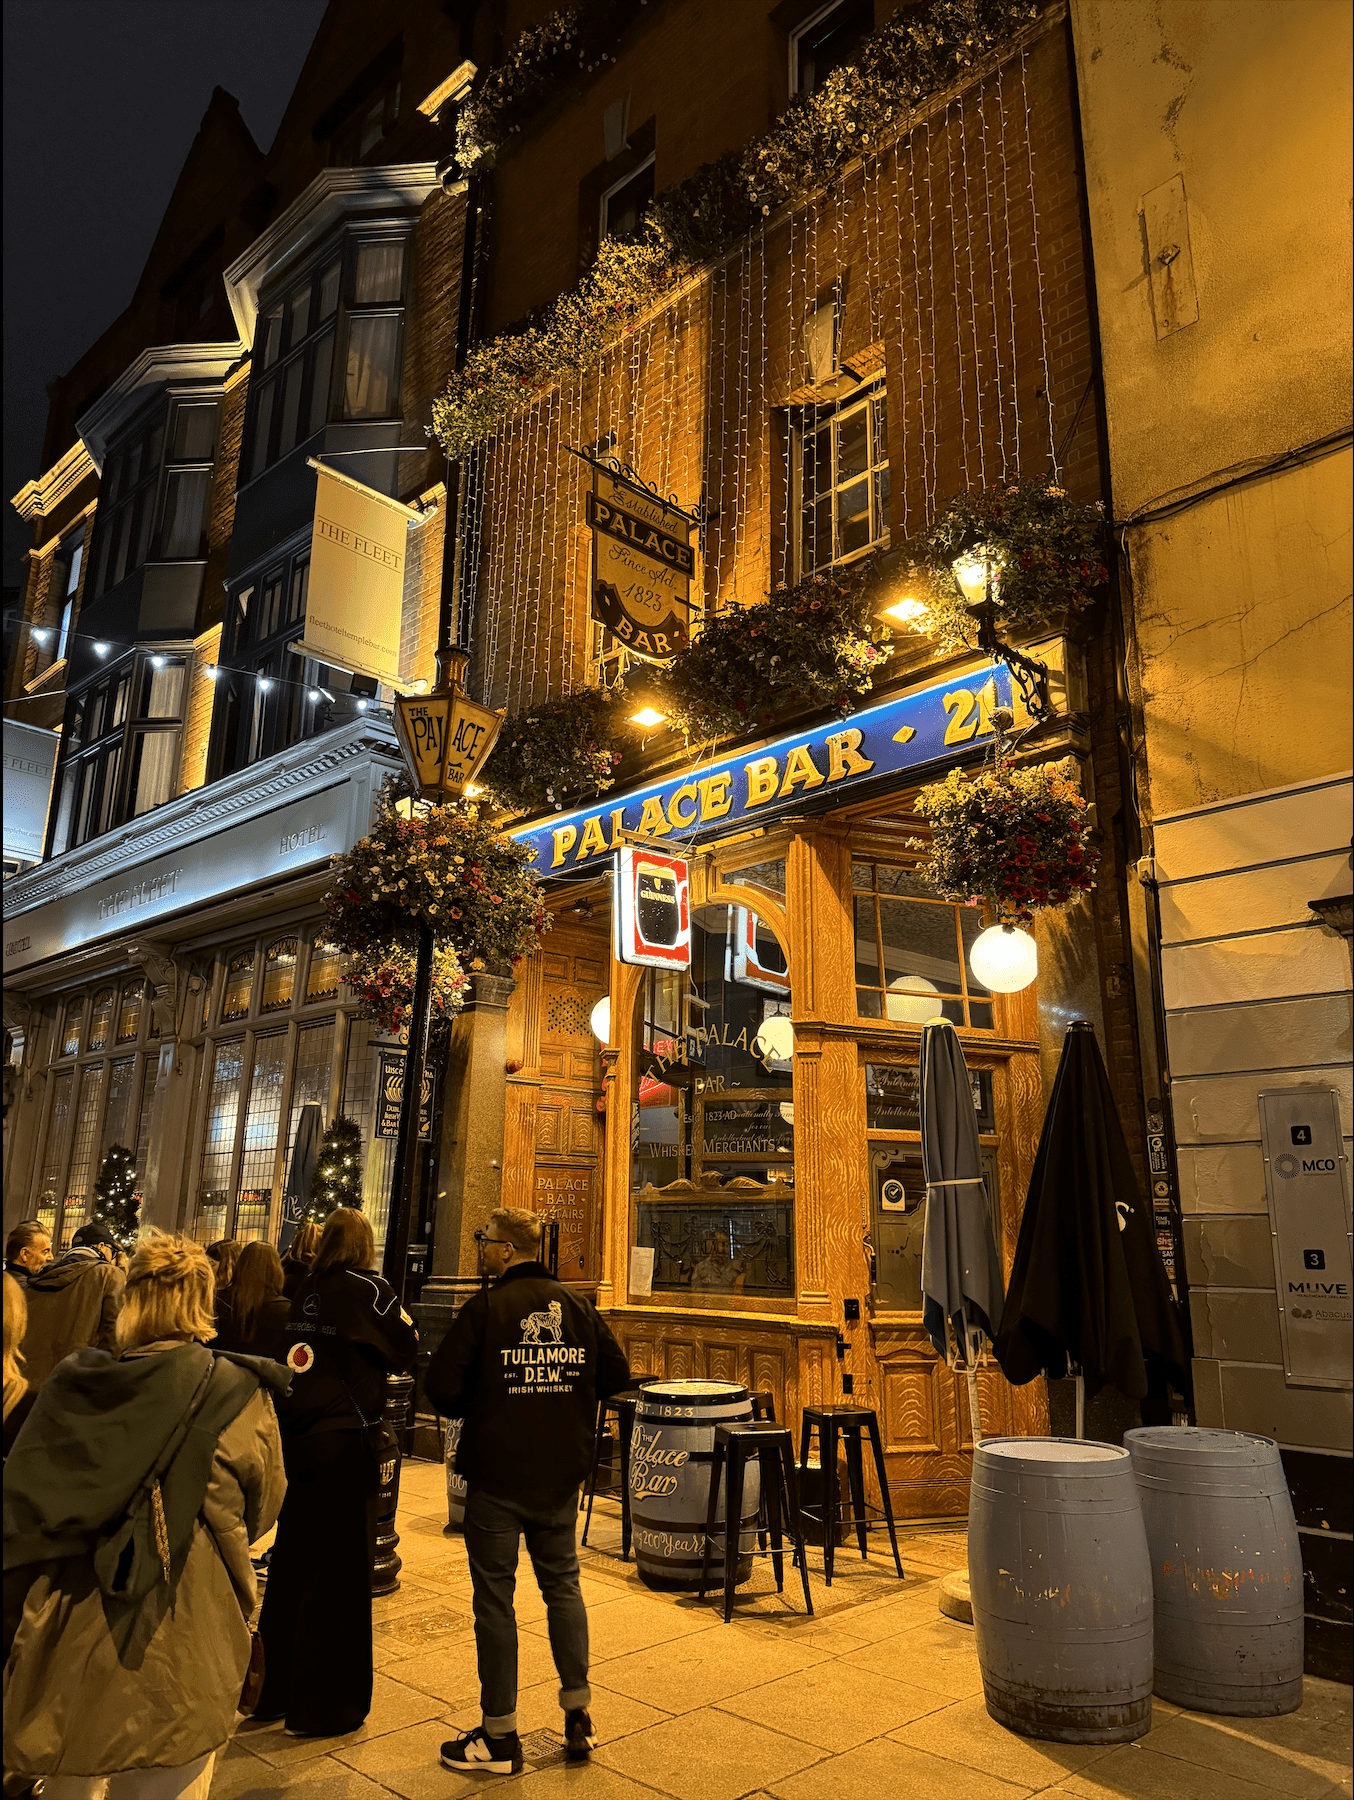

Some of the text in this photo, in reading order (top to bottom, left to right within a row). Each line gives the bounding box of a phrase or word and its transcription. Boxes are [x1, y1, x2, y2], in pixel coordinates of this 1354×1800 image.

[609, 490, 678, 533] Established
[594, 501, 691, 567] PALACE
[318, 519, 402, 569] THE FLEET
[622, 583, 662, 612] 1823
[309, 615, 397, 657] fleethoteltemplebar.com
[614, 614, 672, 654] BAR
[409, 706, 428, 716] THE
[410, 716, 485, 766] PALACE
[448, 768, 465, 783] BAR
[550, 771, 733, 868] PALACE
[744, 728, 875, 809] BAR
[279, 823, 327, 855] HOTEL
[640, 888, 675, 904] GUINNESS
[644, 1023, 781, 1084] THE PALACE
[694, 1075, 725, 1095] BAR
[705, 1111, 722, 1121] 1823
[1296, 1129, 1306, 1142] 4
[702, 1138, 776, 1154] MERCHANTS
[1302, 1159, 1336, 1172] MCO
[536, 1178, 589, 1191] PALACE
[546, 1194, 577, 1205] BAR
[1310, 1253, 1319, 1266] 3
[1288, 1282, 1348, 1294] MUVE
[1316, 1309, 1352, 1318] Abacus
[501, 1347, 585, 1365] TULLAMORE
[525, 1366, 562, 1383] D.E.W.
[508, 1384, 573, 1394] IRISH WHISKEY
[659, 1405, 694, 1418] 1823
[642, 1434, 653, 1442] THE
[630, 1425, 688, 1469] Palace
[630, 1461, 678, 1494] Bar
